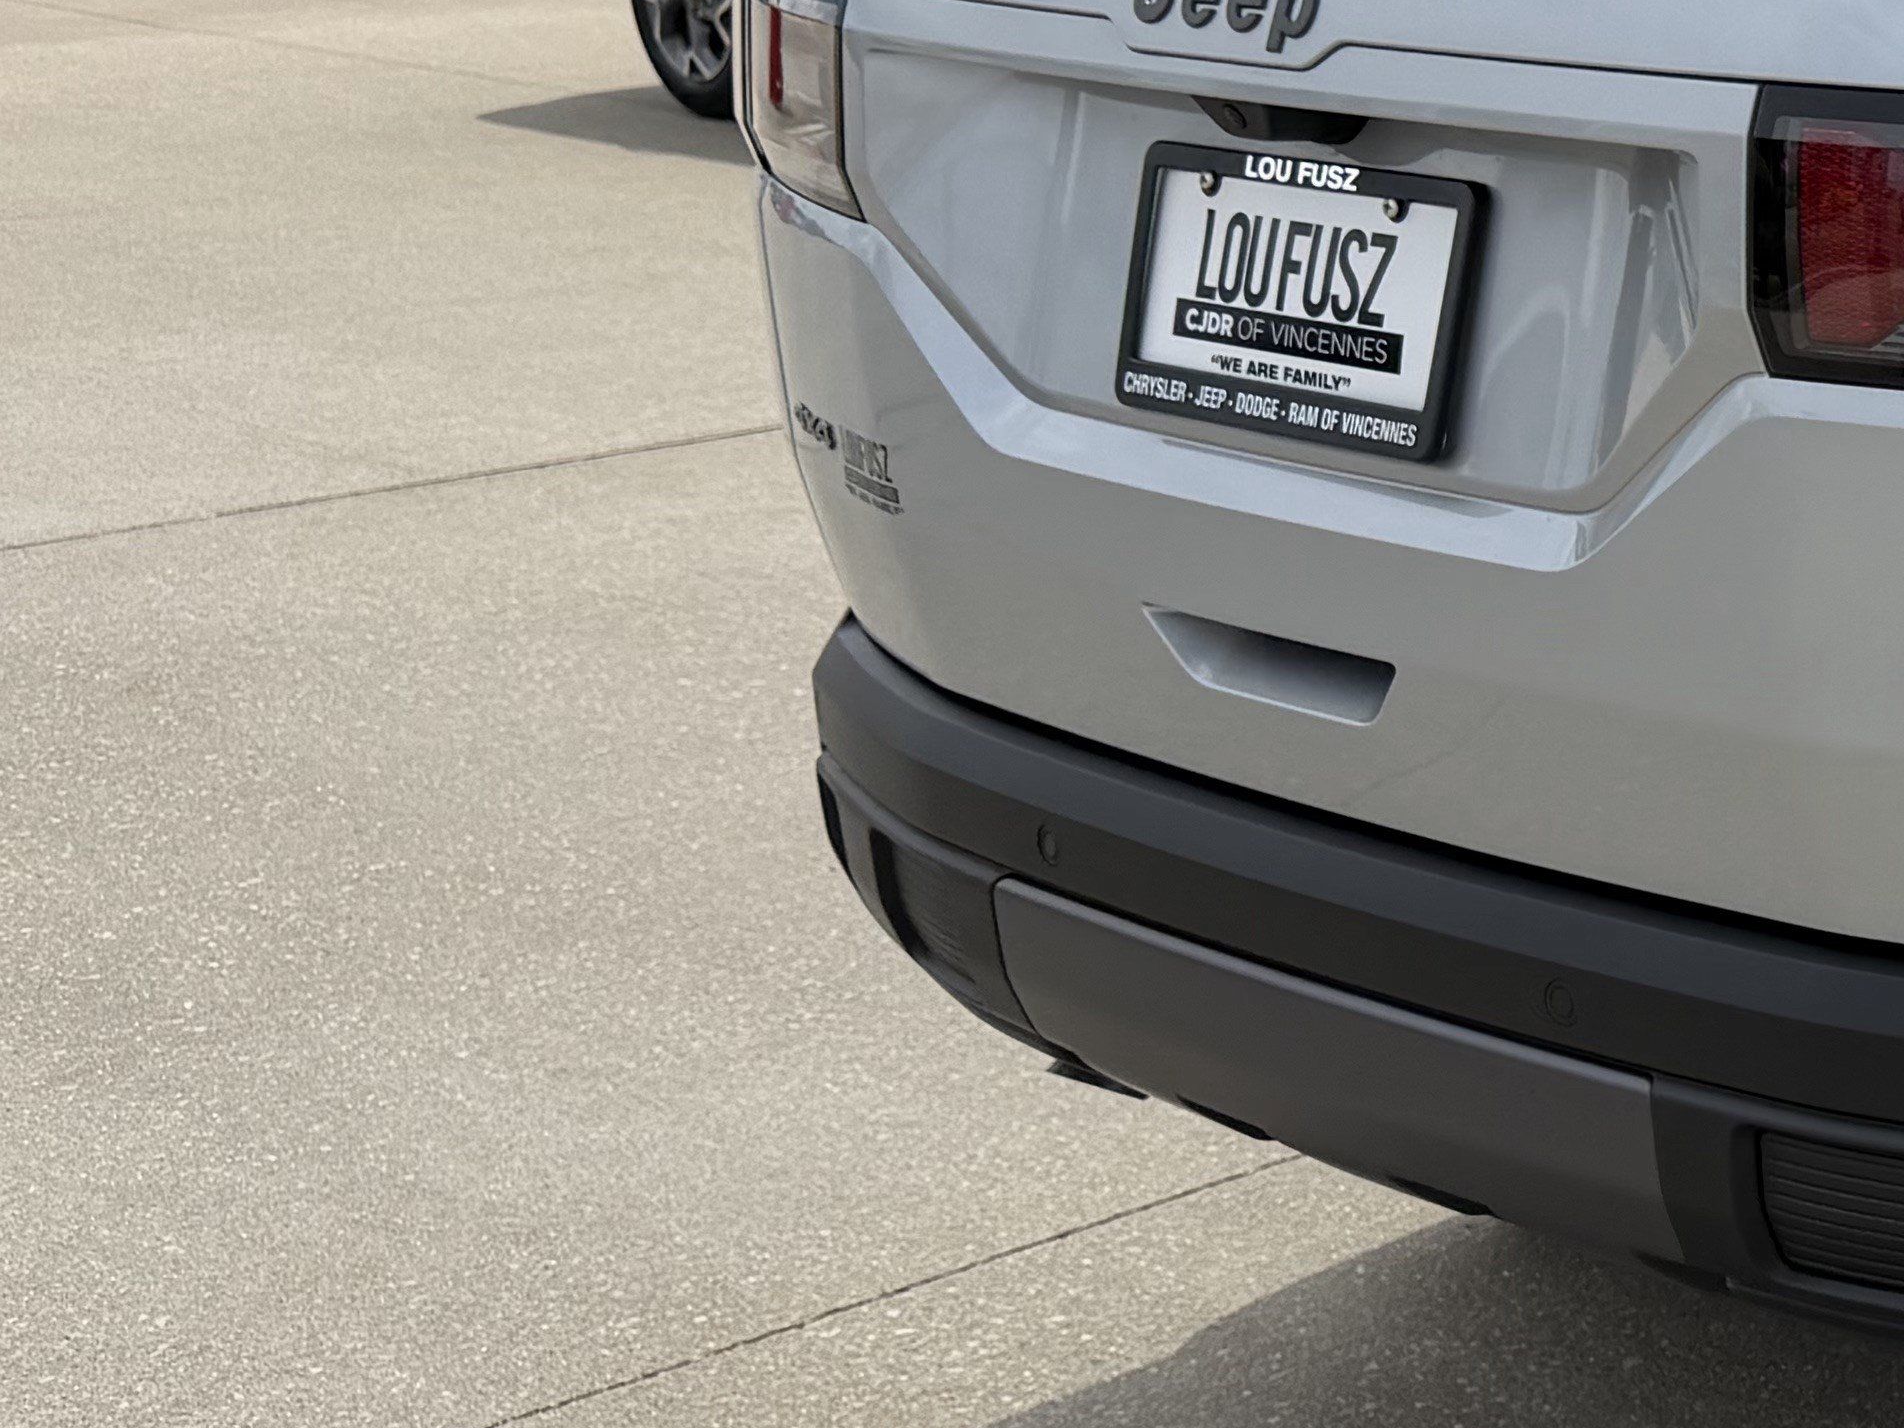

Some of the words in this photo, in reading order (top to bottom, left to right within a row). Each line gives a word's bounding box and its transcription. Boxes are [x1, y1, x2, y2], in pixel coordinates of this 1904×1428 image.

[1244, 155, 1292, 183] LOU
[1297, 161, 1360, 192] FUSZ
[1195, 208, 1281, 309] LOU
[1275, 220, 1398, 327] FUSZ
[1185, 308, 1235, 338] CJDR
[1237, 316, 1264, 342] OF
[1270, 320, 1388, 364] VINCENNES
[1246, 360, 1278, 379] ARE
[1124, 372, 1187, 403] CHRYSLER
[1194, 385, 1227, 410] JEEP
[1235, 392, 1281, 420] DODGE
[1288, 402, 1318, 428] RAM
[1321, 409, 1339, 431] OF
[1341, 412, 1417, 447] VINCENNES
